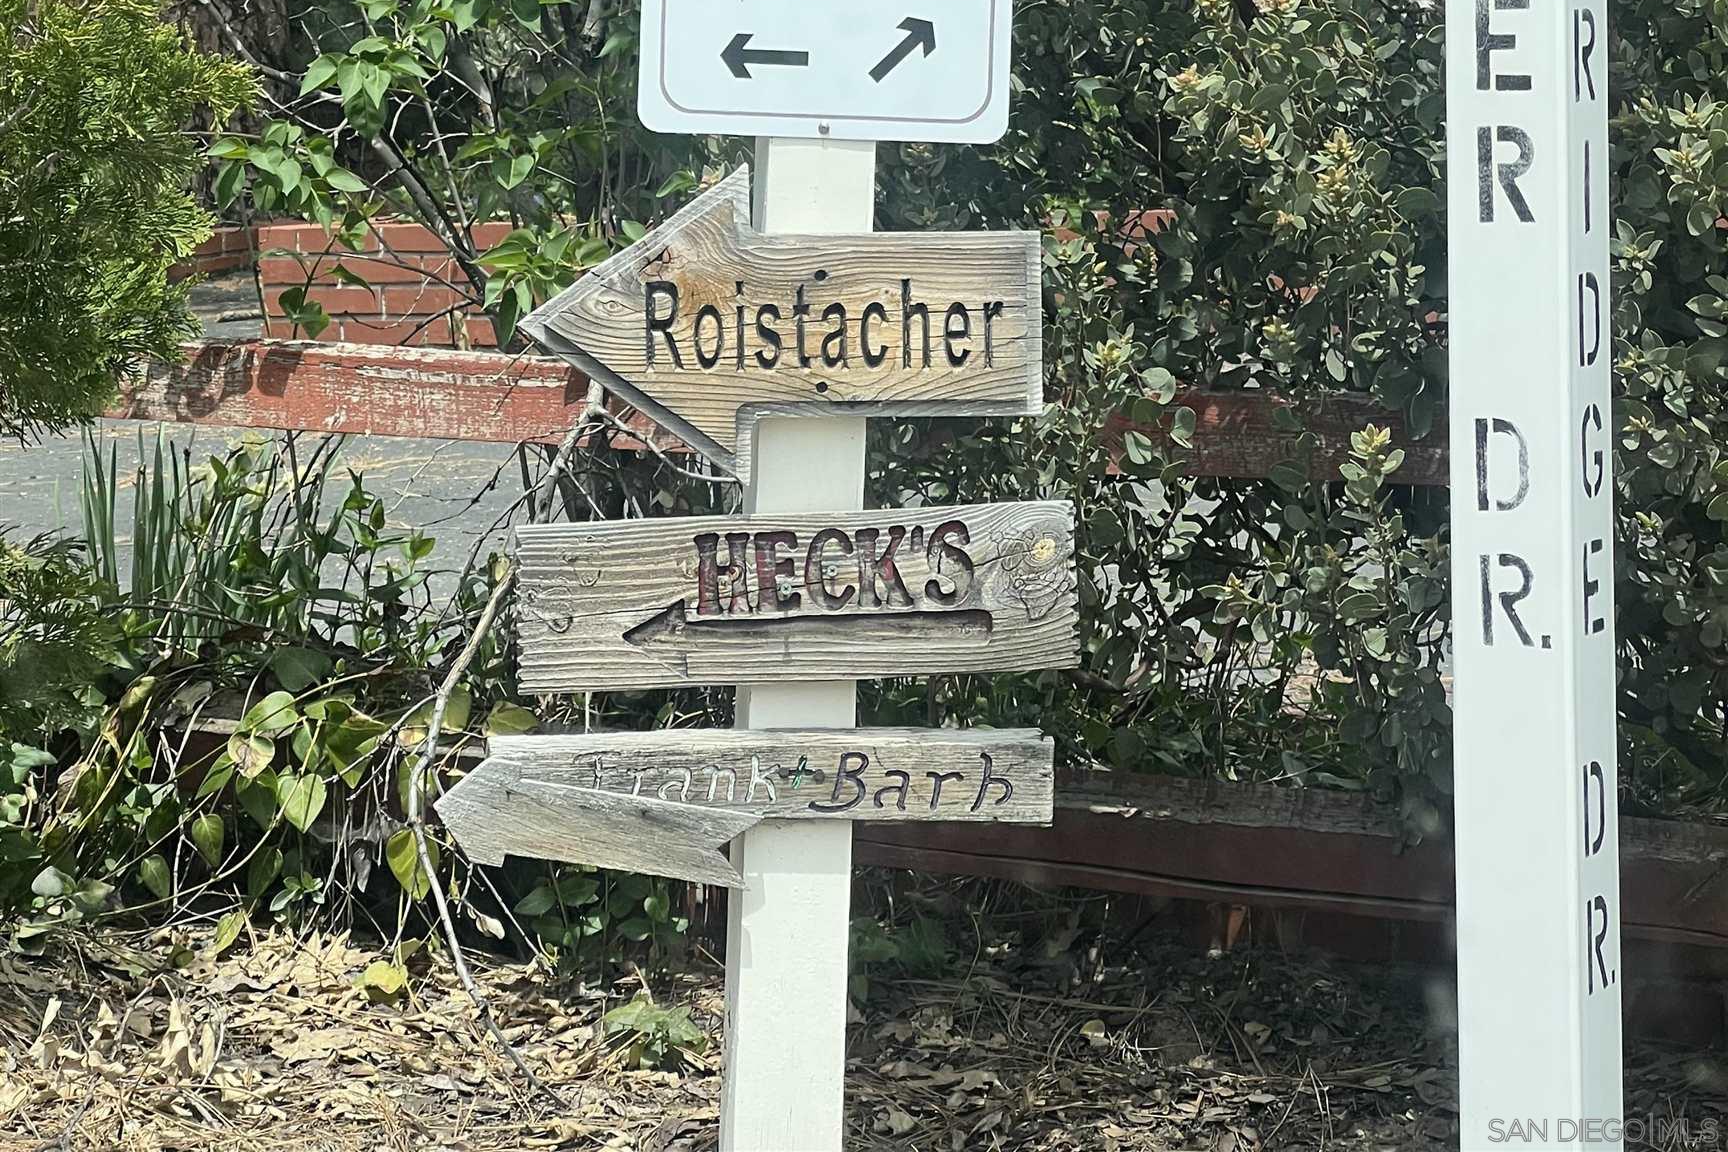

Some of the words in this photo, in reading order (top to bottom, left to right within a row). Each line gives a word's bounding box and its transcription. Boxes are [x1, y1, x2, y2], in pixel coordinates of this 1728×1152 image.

[644, 279, 1003, 372] Roistacher
[1573, 8, 1604, 636] RIDGE
[693, 520, 975, 616] HECK'S
[1474, 417, 1552, 648] DR.
[573, 751, 780, 803] Frank
[1582, 760, 1617, 996] DR.
